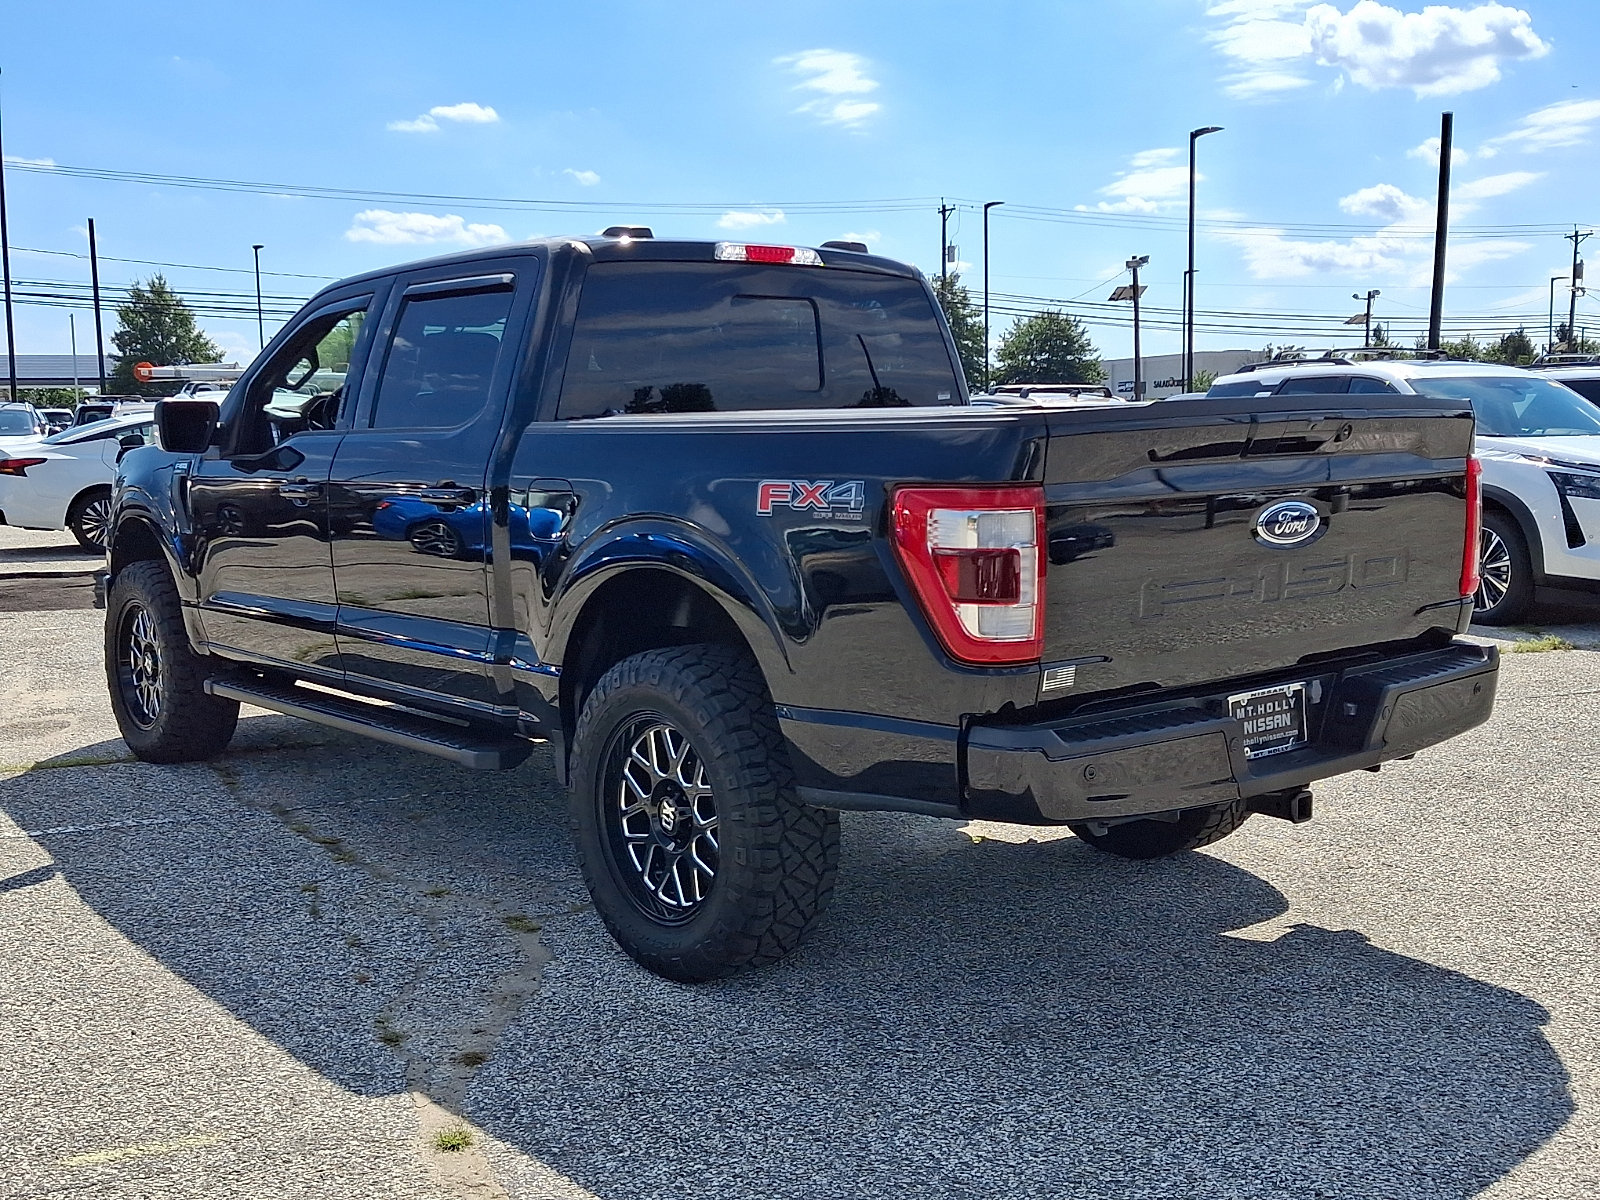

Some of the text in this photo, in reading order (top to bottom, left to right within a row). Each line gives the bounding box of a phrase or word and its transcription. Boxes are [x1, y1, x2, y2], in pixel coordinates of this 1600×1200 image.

[756, 480, 865, 516] FX4
[1274, 511, 1309, 535] Ford
[1139, 550, 1409, 620] F-150
[1250, 688, 1285, 698] NISSAN
[1243, 713, 1291, 735] NISSAN
[1243, 729, 1299, 746] thollynissan.com
